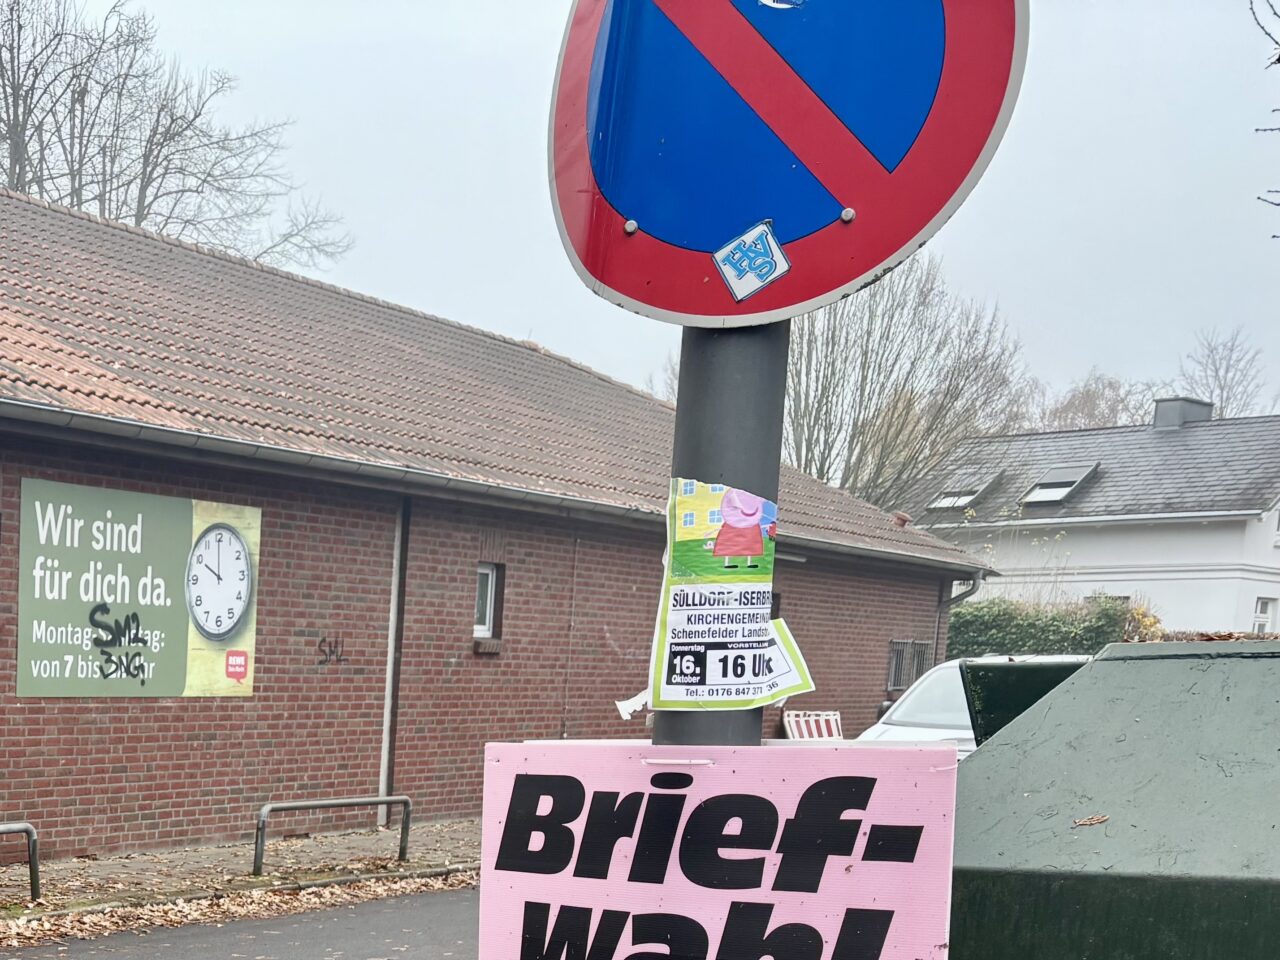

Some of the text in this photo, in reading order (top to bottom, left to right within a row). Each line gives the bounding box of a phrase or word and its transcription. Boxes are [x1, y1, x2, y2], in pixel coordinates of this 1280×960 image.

[35, 500, 143, 554] Wir sind
[196, 553, 204, 564] 10
[235, 550, 242, 561] 2
[32, 555, 172, 607] für dich da.
[191, 574, 199, 585] 9
[238, 570, 246, 581] 3
[194, 595, 203, 607] 8
[235, 590, 242, 601] 4
[203, 611, 210, 623] 7
[227, 608, 235, 620] 5
[215, 615, 223, 628] 6
[671, 627, 739, 640] Schenefelder
[671, 644, 705, 653] Donnerstag
[31, 659, 60, 678] von
[63, 654, 74, 678] 7
[77, 654, 101, 679] bis
[673, 655, 701, 675] 16.
[718, 654, 746, 679] 16
[671, 674, 701, 684] Oktober
[685, 688, 705, 697] Tel.:
[707, 688, 733, 697] 0176
[734, 687, 751, 696] 847
[766, 681, 779, 692] 36
[494, 772, 924, 893] Brief-
